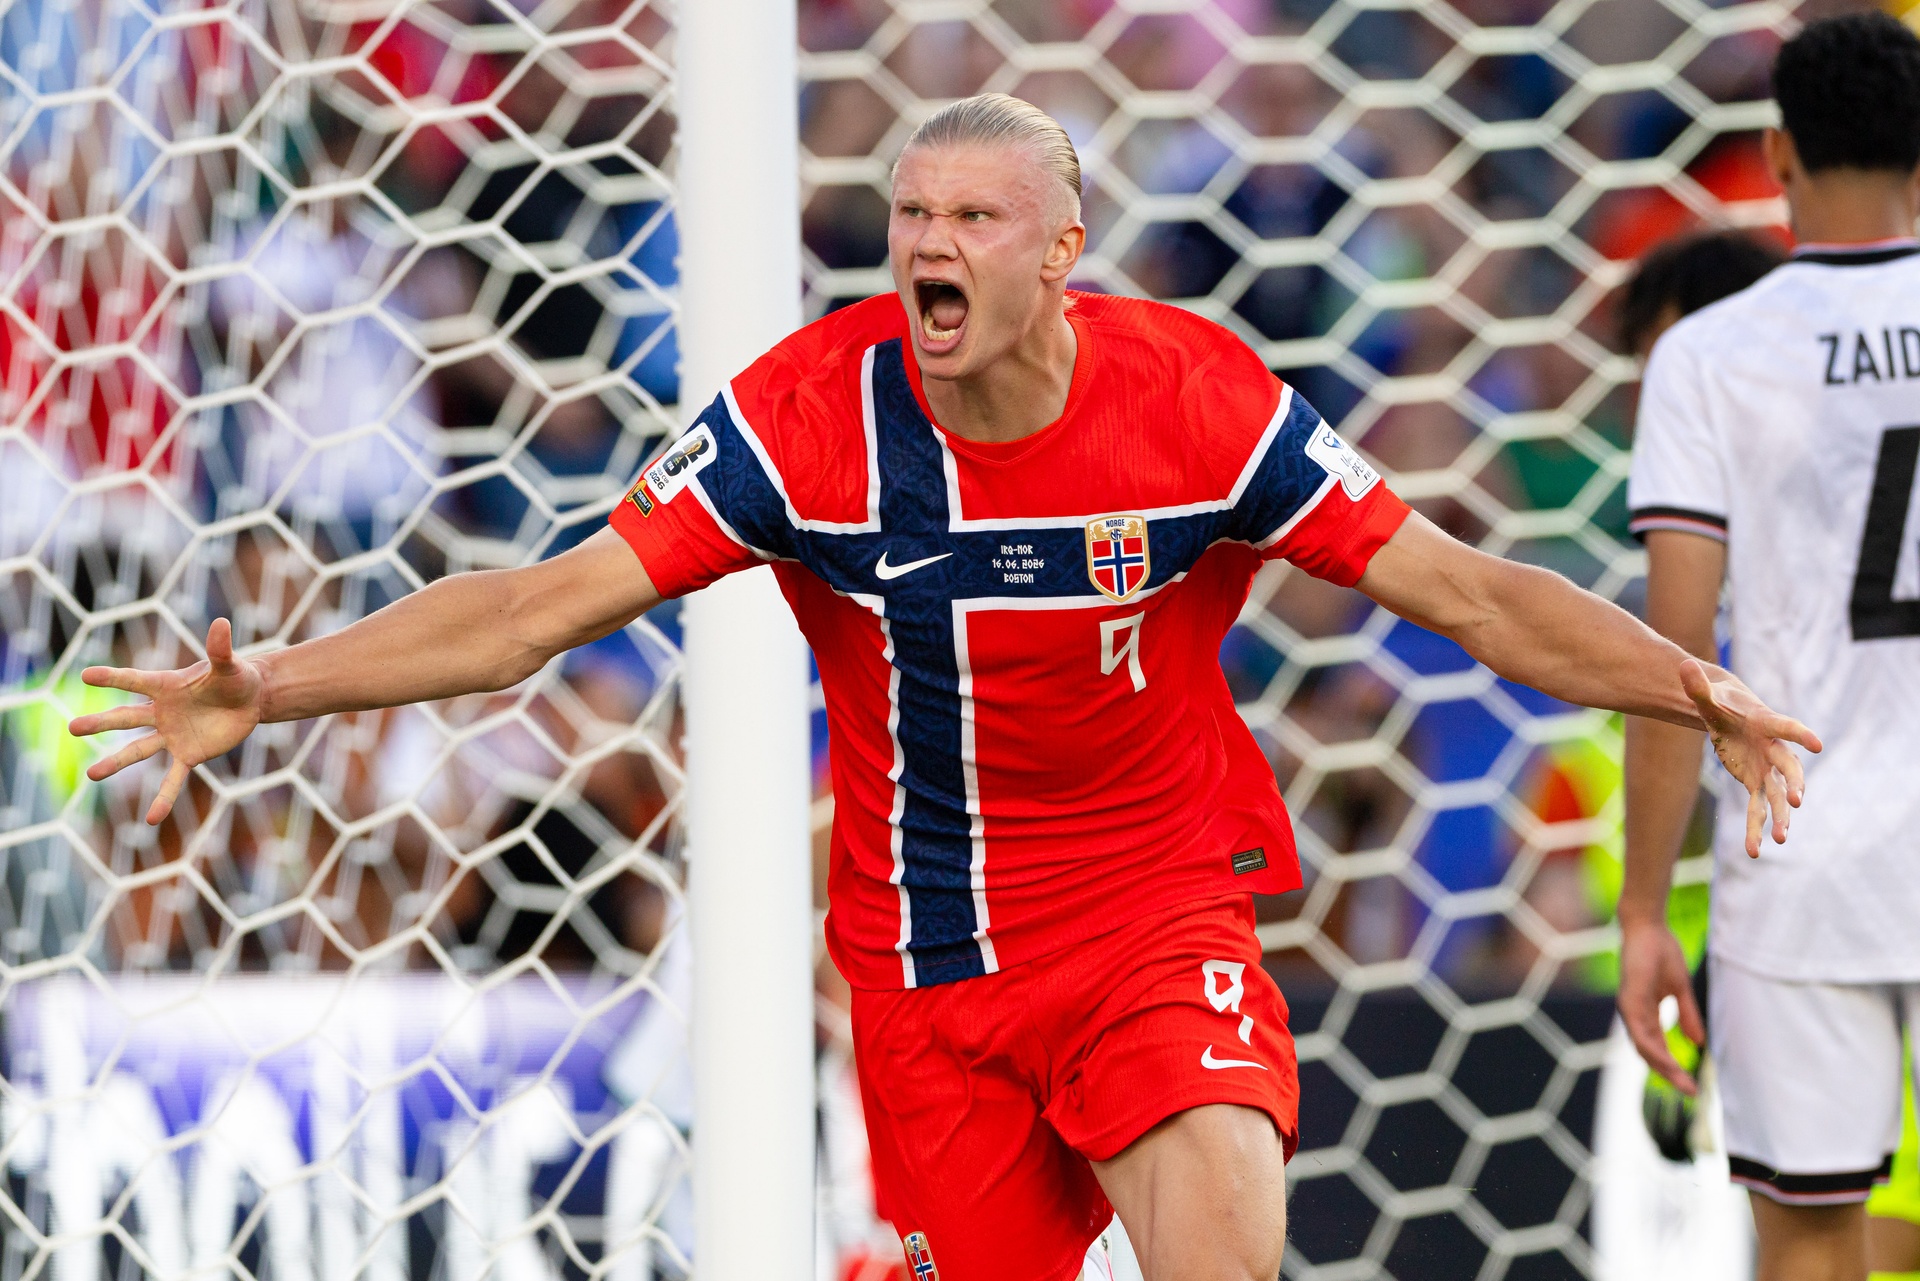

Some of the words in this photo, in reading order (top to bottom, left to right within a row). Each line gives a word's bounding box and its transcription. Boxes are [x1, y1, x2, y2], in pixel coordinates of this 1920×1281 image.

[1817, 328, 1920, 384] ZAID
[649, 470, 665, 490] 2026
[636, 491, 652, 509] DEBUT
[1105, 518, 1125, 527] NORGE
[1000, 544, 1034, 555] IRQ-NOR
[1003, 573, 1034, 584] BOSTON
[1099, 610, 1147, 693] 9
[1202, 959, 1254, 1046] 9
